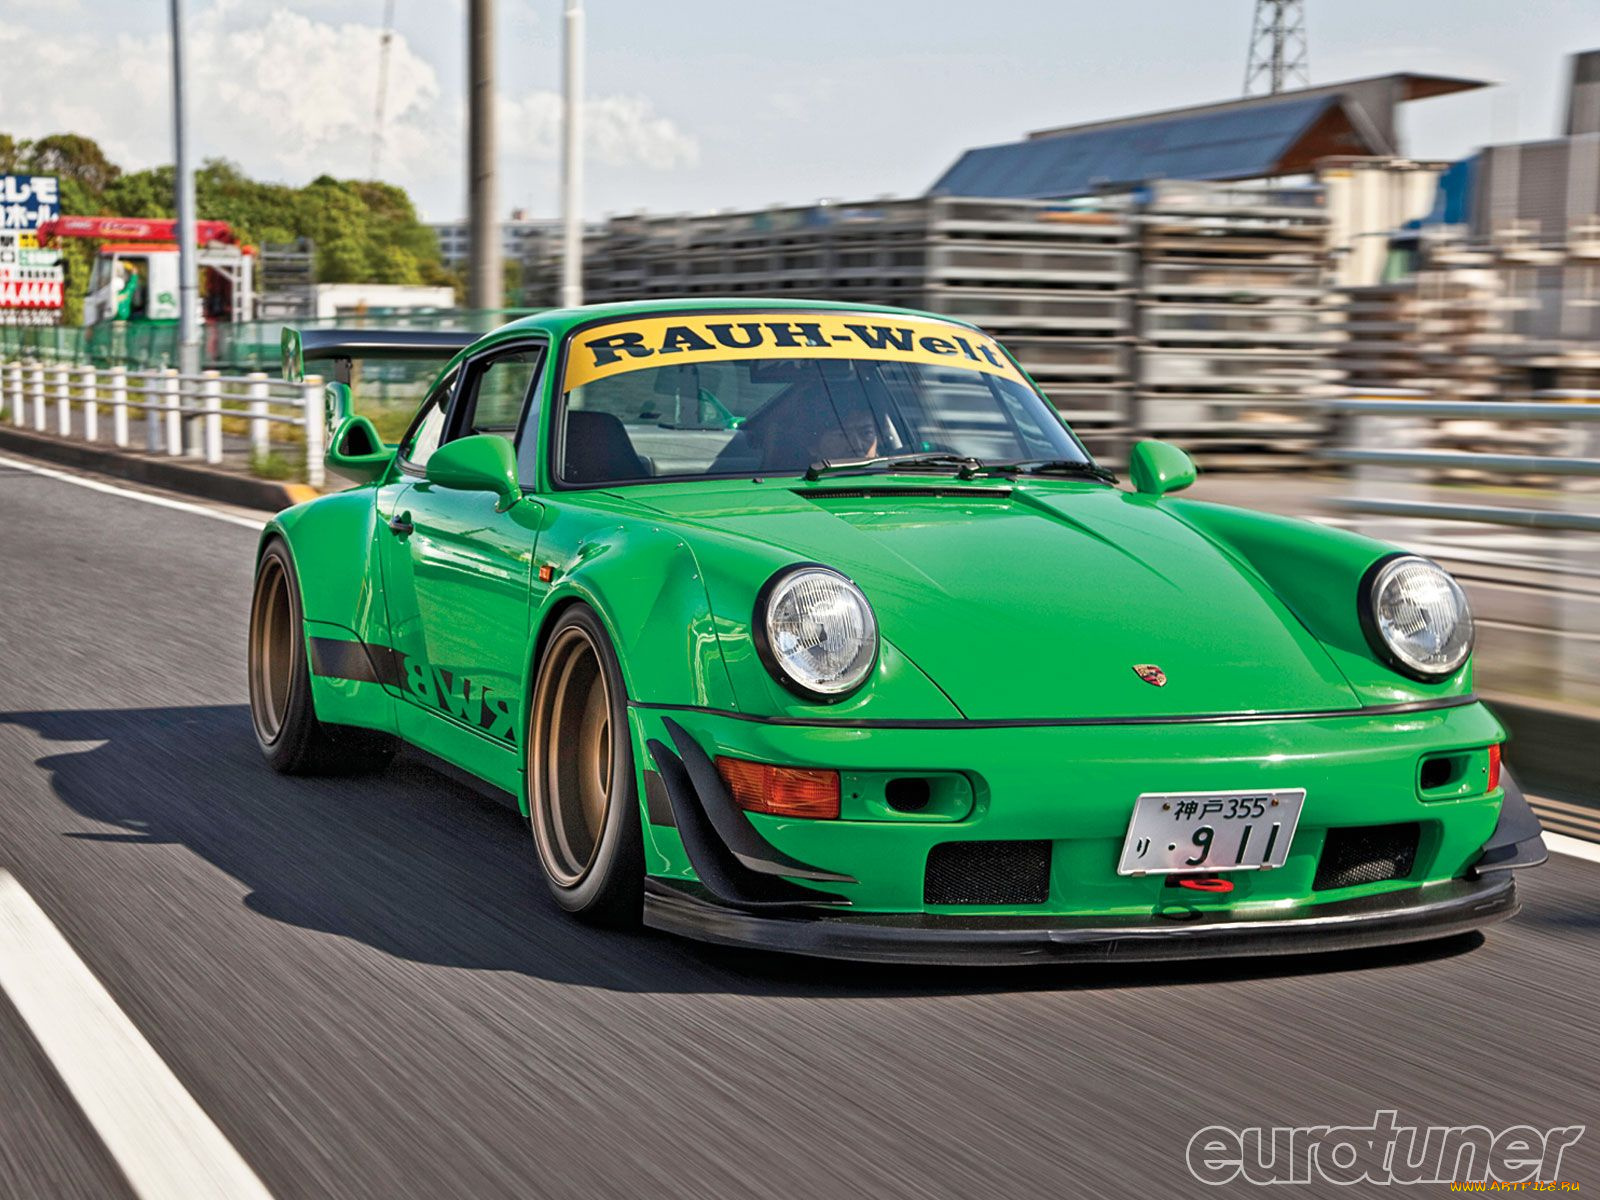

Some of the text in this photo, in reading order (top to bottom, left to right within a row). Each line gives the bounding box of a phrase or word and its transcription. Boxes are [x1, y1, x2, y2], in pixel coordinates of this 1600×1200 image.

[0, 176, 58, 204] レモ
[0, 203, 59, 229] ホール
[585, 321, 1004, 369] RAUH-Welt
